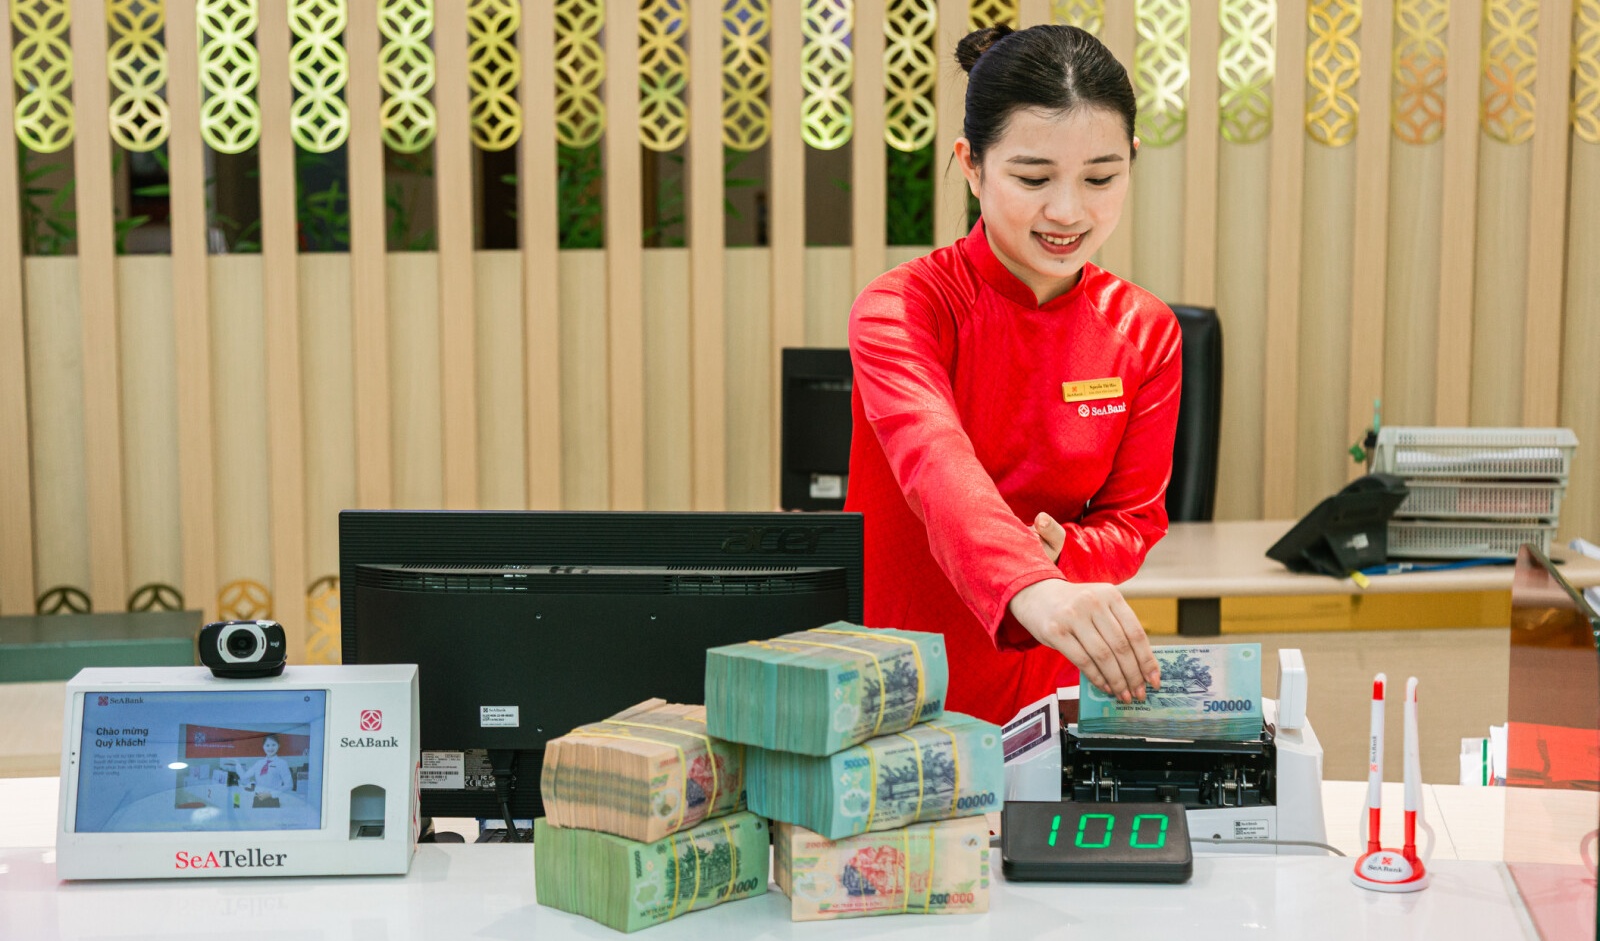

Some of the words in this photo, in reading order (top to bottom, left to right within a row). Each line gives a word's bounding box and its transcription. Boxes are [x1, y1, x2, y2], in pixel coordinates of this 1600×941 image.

[1092, 402, 1126, 416] SeABank
[721, 526, 835, 554] acer
[1203, 699, 1252, 712] 500000
[96, 727, 120, 736] Chào
[115, 738, 146, 747] khách!
[340, 736, 399, 748] SeABank
[1048, 814, 1169, 849] 100
[175, 848, 287, 869] SeATeller
[1367, 864, 1402, 873] SeABank
[929, 892, 975, 905] 200000
